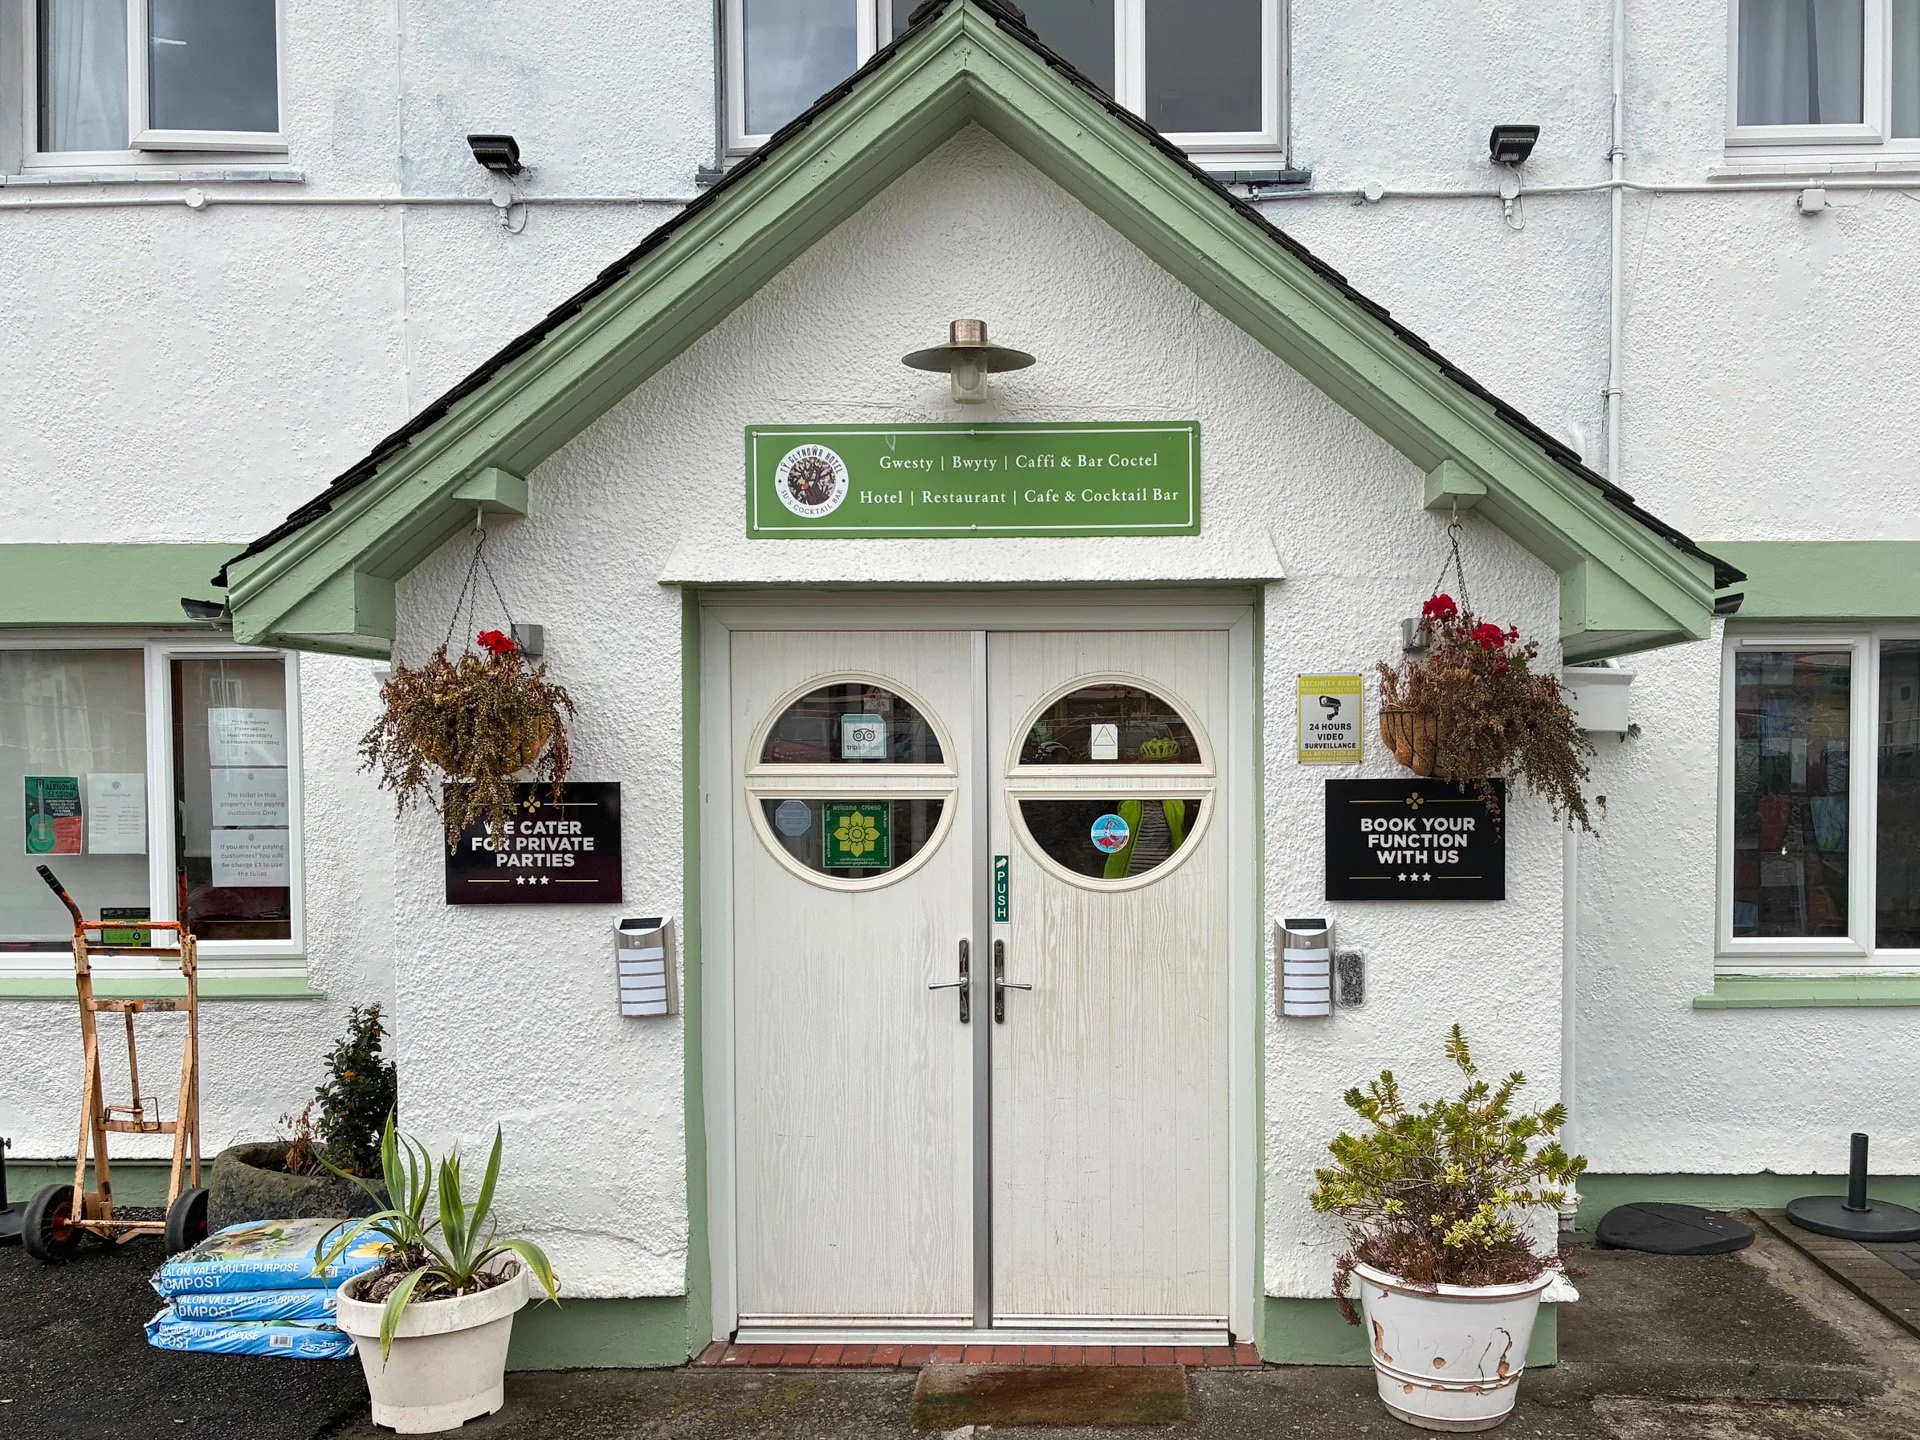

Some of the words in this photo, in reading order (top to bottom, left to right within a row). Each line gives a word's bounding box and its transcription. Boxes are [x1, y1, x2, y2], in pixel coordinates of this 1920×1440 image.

[825, 452, 844, 475] HOTEL
[879, 456, 933, 472] Gwesty
[952, 456, 997, 472] Bwyty
[1015, 454, 1055, 468] Caffi
[1060, 455, 1072, 468] &
[1077, 454, 1103, 467] Bar
[1108, 453, 1158, 467] Coctel
[793, 503, 833, 516] COCKTAIL
[832, 489, 843, 504] BAR
[859, 490, 903, 504] Hotel
[922, 490, 1006, 504] Restaurant
[1024, 489, 1060, 503] Cafe
[1064, 490, 1076, 502] &
[1081, 488, 1147, 502] Cocktail
[1152, 488, 1178, 501] Bar
[1309, 723, 1319, 731] 24
[1321, 723, 1352, 731] HOURS
[1317, 733, 1344, 741] VIDEO
[519, 821, 582, 835] CATER
[1360, 818, 1416, 832] BOOK
[1421, 817, 1476, 832] YOUR
[471, 837, 511, 851] FOR
[515, 837, 595, 851] PRIVATE
[1367, 834, 1468, 848] FUNCTION
[496, 853, 575, 867] PARTIES
[1376, 850, 1428, 864] WITH
[1433, 850, 1460, 864] US
[997, 871, 1007, 918] PUSH
[192, 1264, 217, 1275] VALE
[219, 1262, 300, 1274] MULTI-PURPOSE
[164, 1275, 222, 1290] OMPOST
[209, 1295, 232, 1305] VALE
